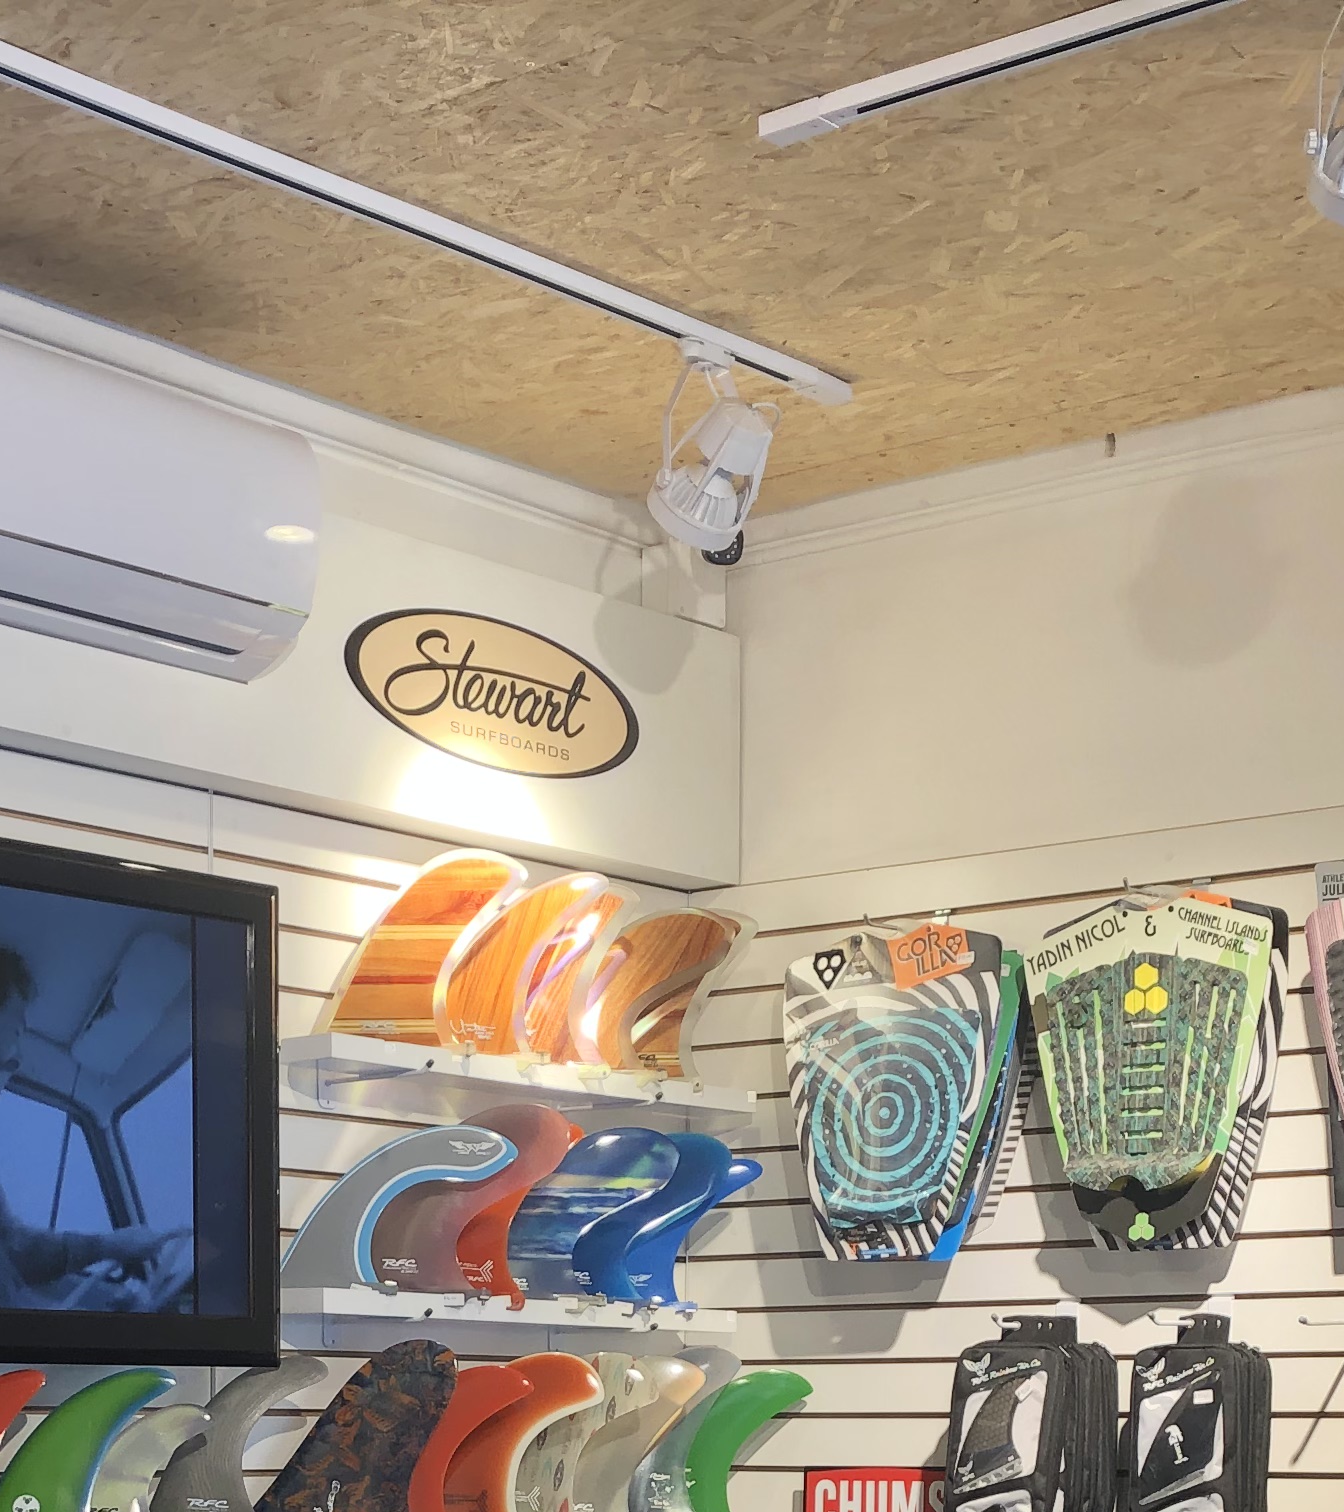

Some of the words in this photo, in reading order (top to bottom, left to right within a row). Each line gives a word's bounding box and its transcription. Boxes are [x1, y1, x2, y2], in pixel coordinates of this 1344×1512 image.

[384, 629, 591, 738] Stewart
[450, 720, 571, 762] SURFBOARDS
[1026, 939, 1074, 976] YADIN
[1075, 914, 1125, 952] NICOL
[1178, 907, 1224, 931] CHANNEL
[1224, 917, 1269, 943] ISLANDS
[1186, 926, 1251, 955] SURFBOAR
